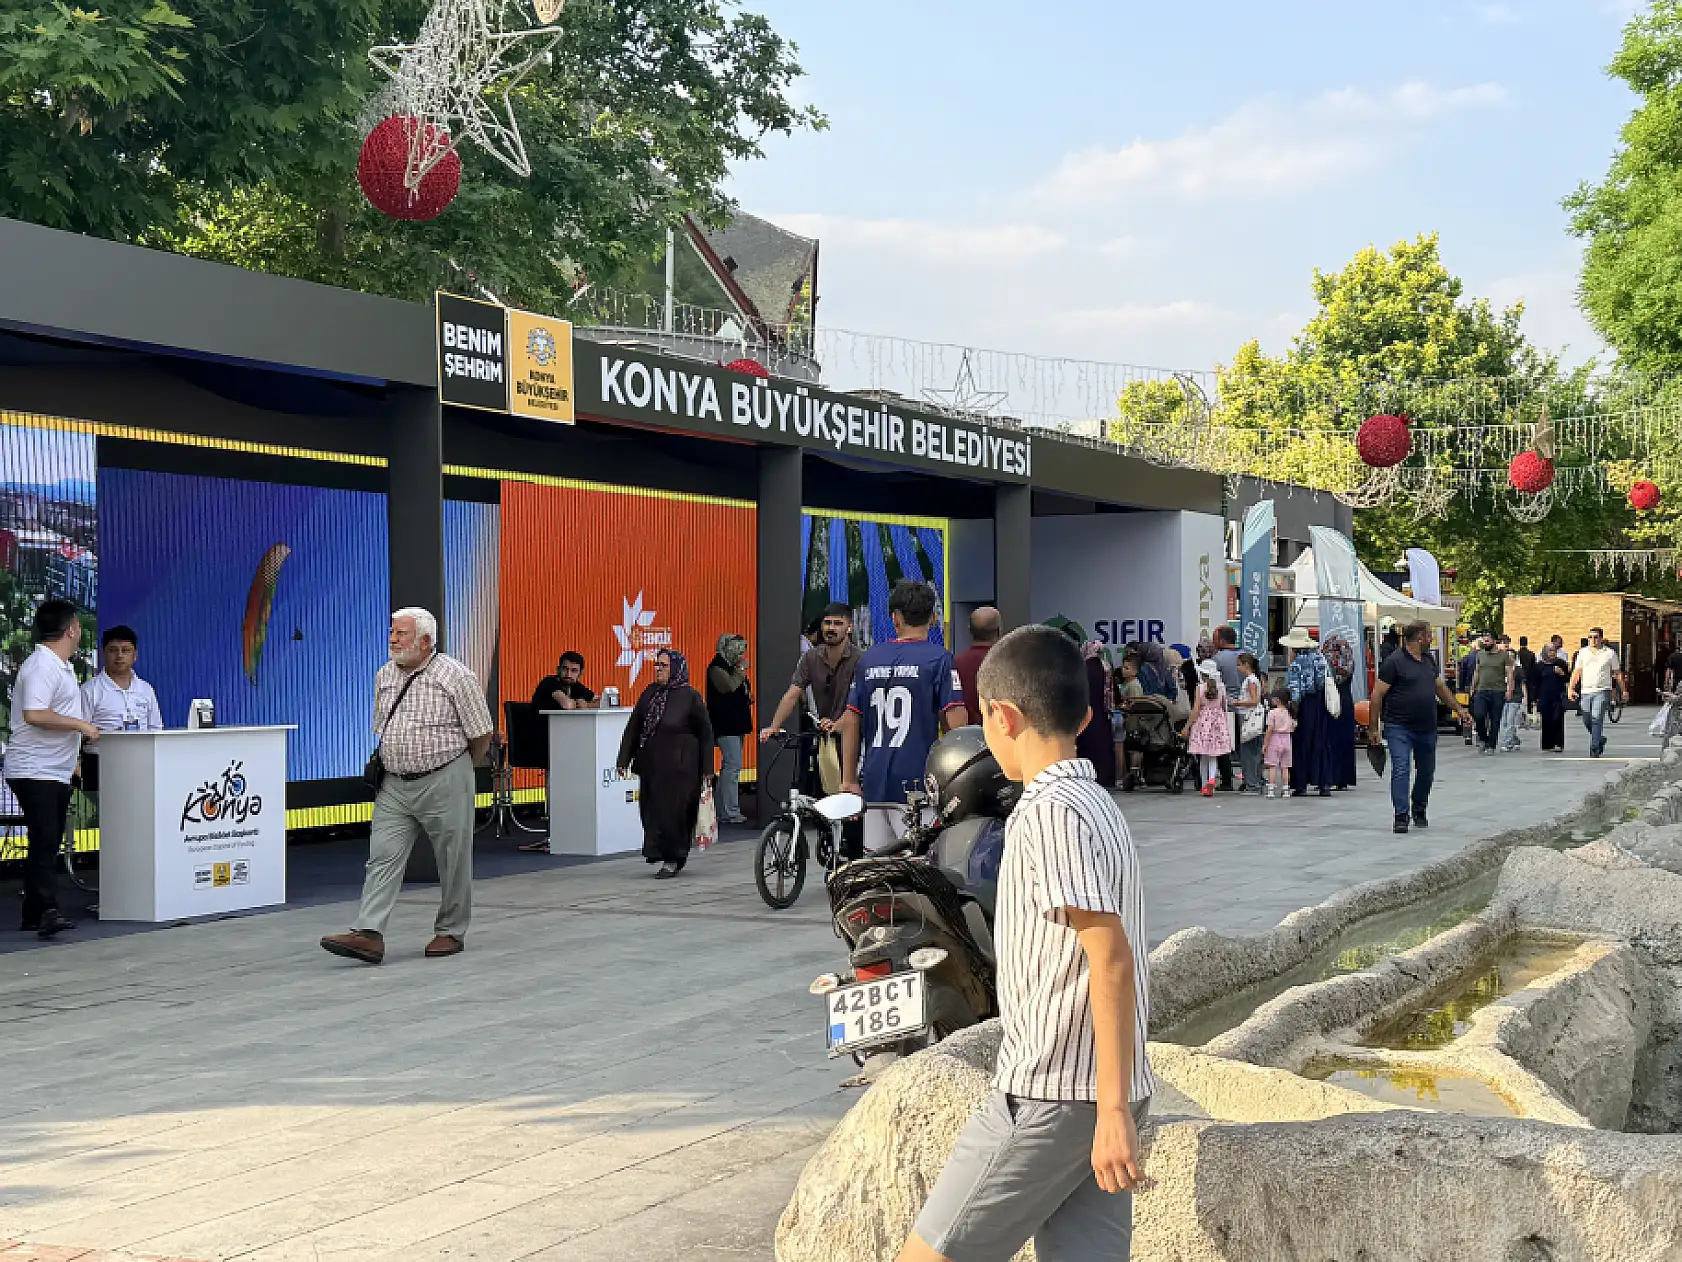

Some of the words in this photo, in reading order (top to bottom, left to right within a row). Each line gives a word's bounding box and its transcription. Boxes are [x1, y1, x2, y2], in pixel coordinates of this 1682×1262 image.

[443, 321, 502, 357] BENİM
[444, 352, 503, 384] ŞEHRİM
[601, 356, 723, 422] KONYA
[731, 376, 904, 453] BÜYÜKŞEHİR
[912, 417, 1032, 477] BELEDİYESİ
[1094, 619, 1165, 645] SIFIR
[870, 686, 912, 748] 19
[180, 793, 262, 832] Konya
[854, 1006, 901, 1037] 186
